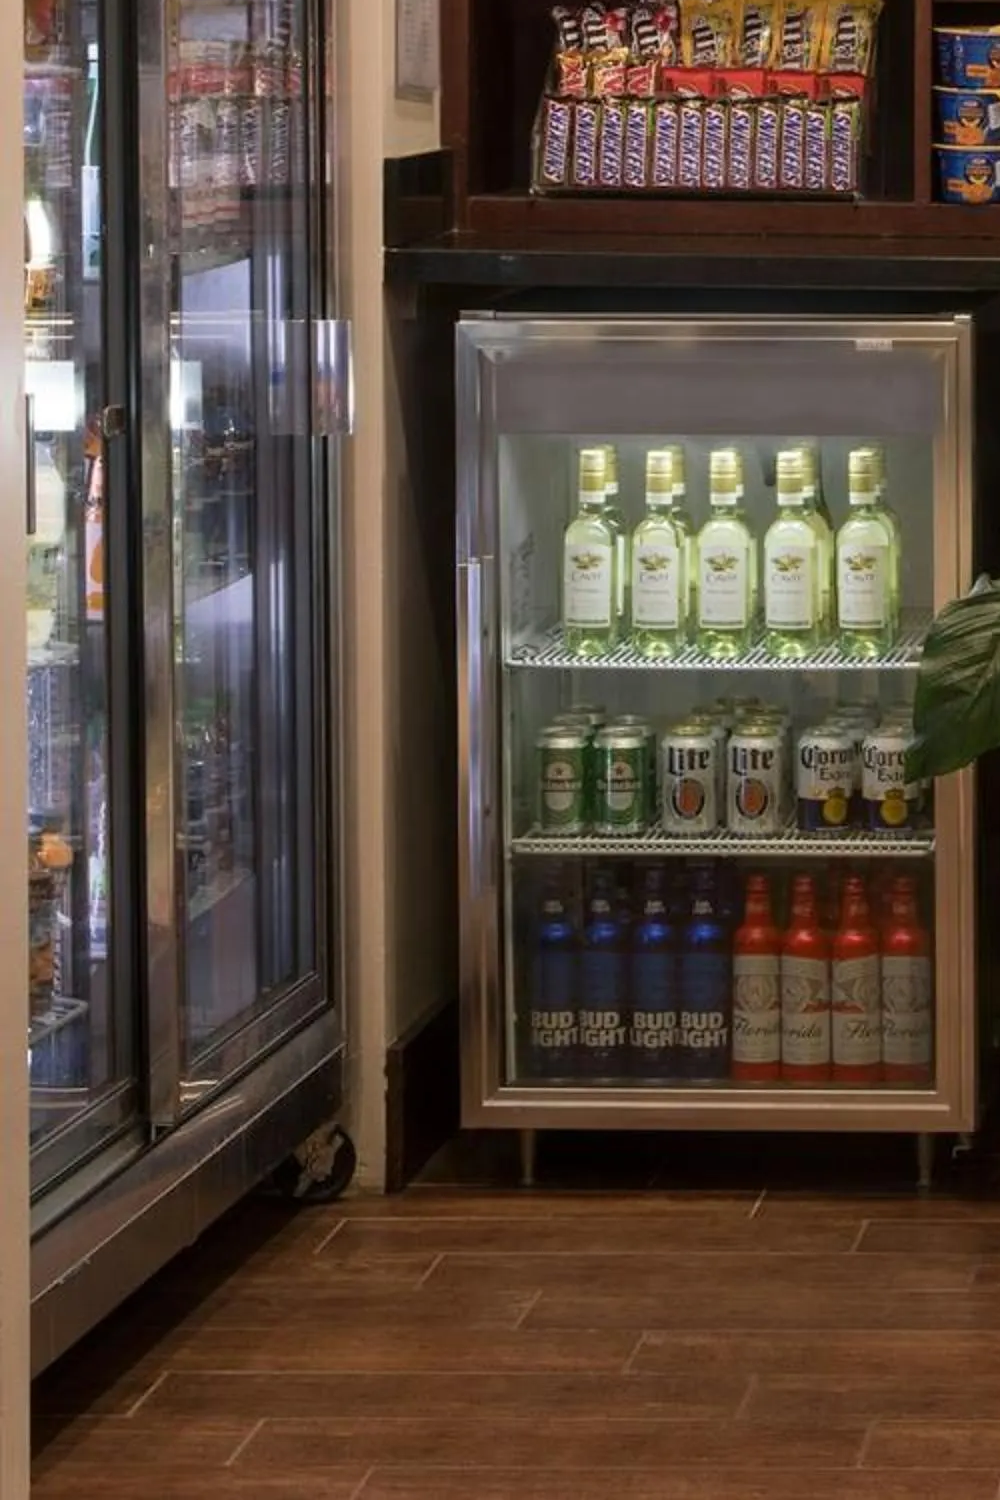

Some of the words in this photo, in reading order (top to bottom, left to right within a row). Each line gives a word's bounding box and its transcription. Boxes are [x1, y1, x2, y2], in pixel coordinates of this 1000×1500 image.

[545, 103, 567, 181] SNICKERS
[576, 108, 595, 185] SNICKERS
[602, 108, 621, 185] SNICKERS
[626, 108, 646, 186] SNICKERS
[655, 110, 677, 186] SNICKERS
[681, 110, 701, 187] SNICKERS
[704, 109, 724, 187] SNICKERS
[730, 111, 750, 188] SNICKERS
[757, 110, 777, 186] SNICKERS
[783, 107, 803, 186] SNICKERS
[805, 112, 826, 189] SNICKERS
[831, 112, 851, 190] SNICKERS
[668, 746, 710, 776] Lite
[732, 746, 774, 776] Lite
[532, 1010, 574, 1029] BUD
[579, 1010, 620, 1029] BUD
[633, 1010, 676, 1029] BUD
[680, 1010, 723, 1029] BUD
